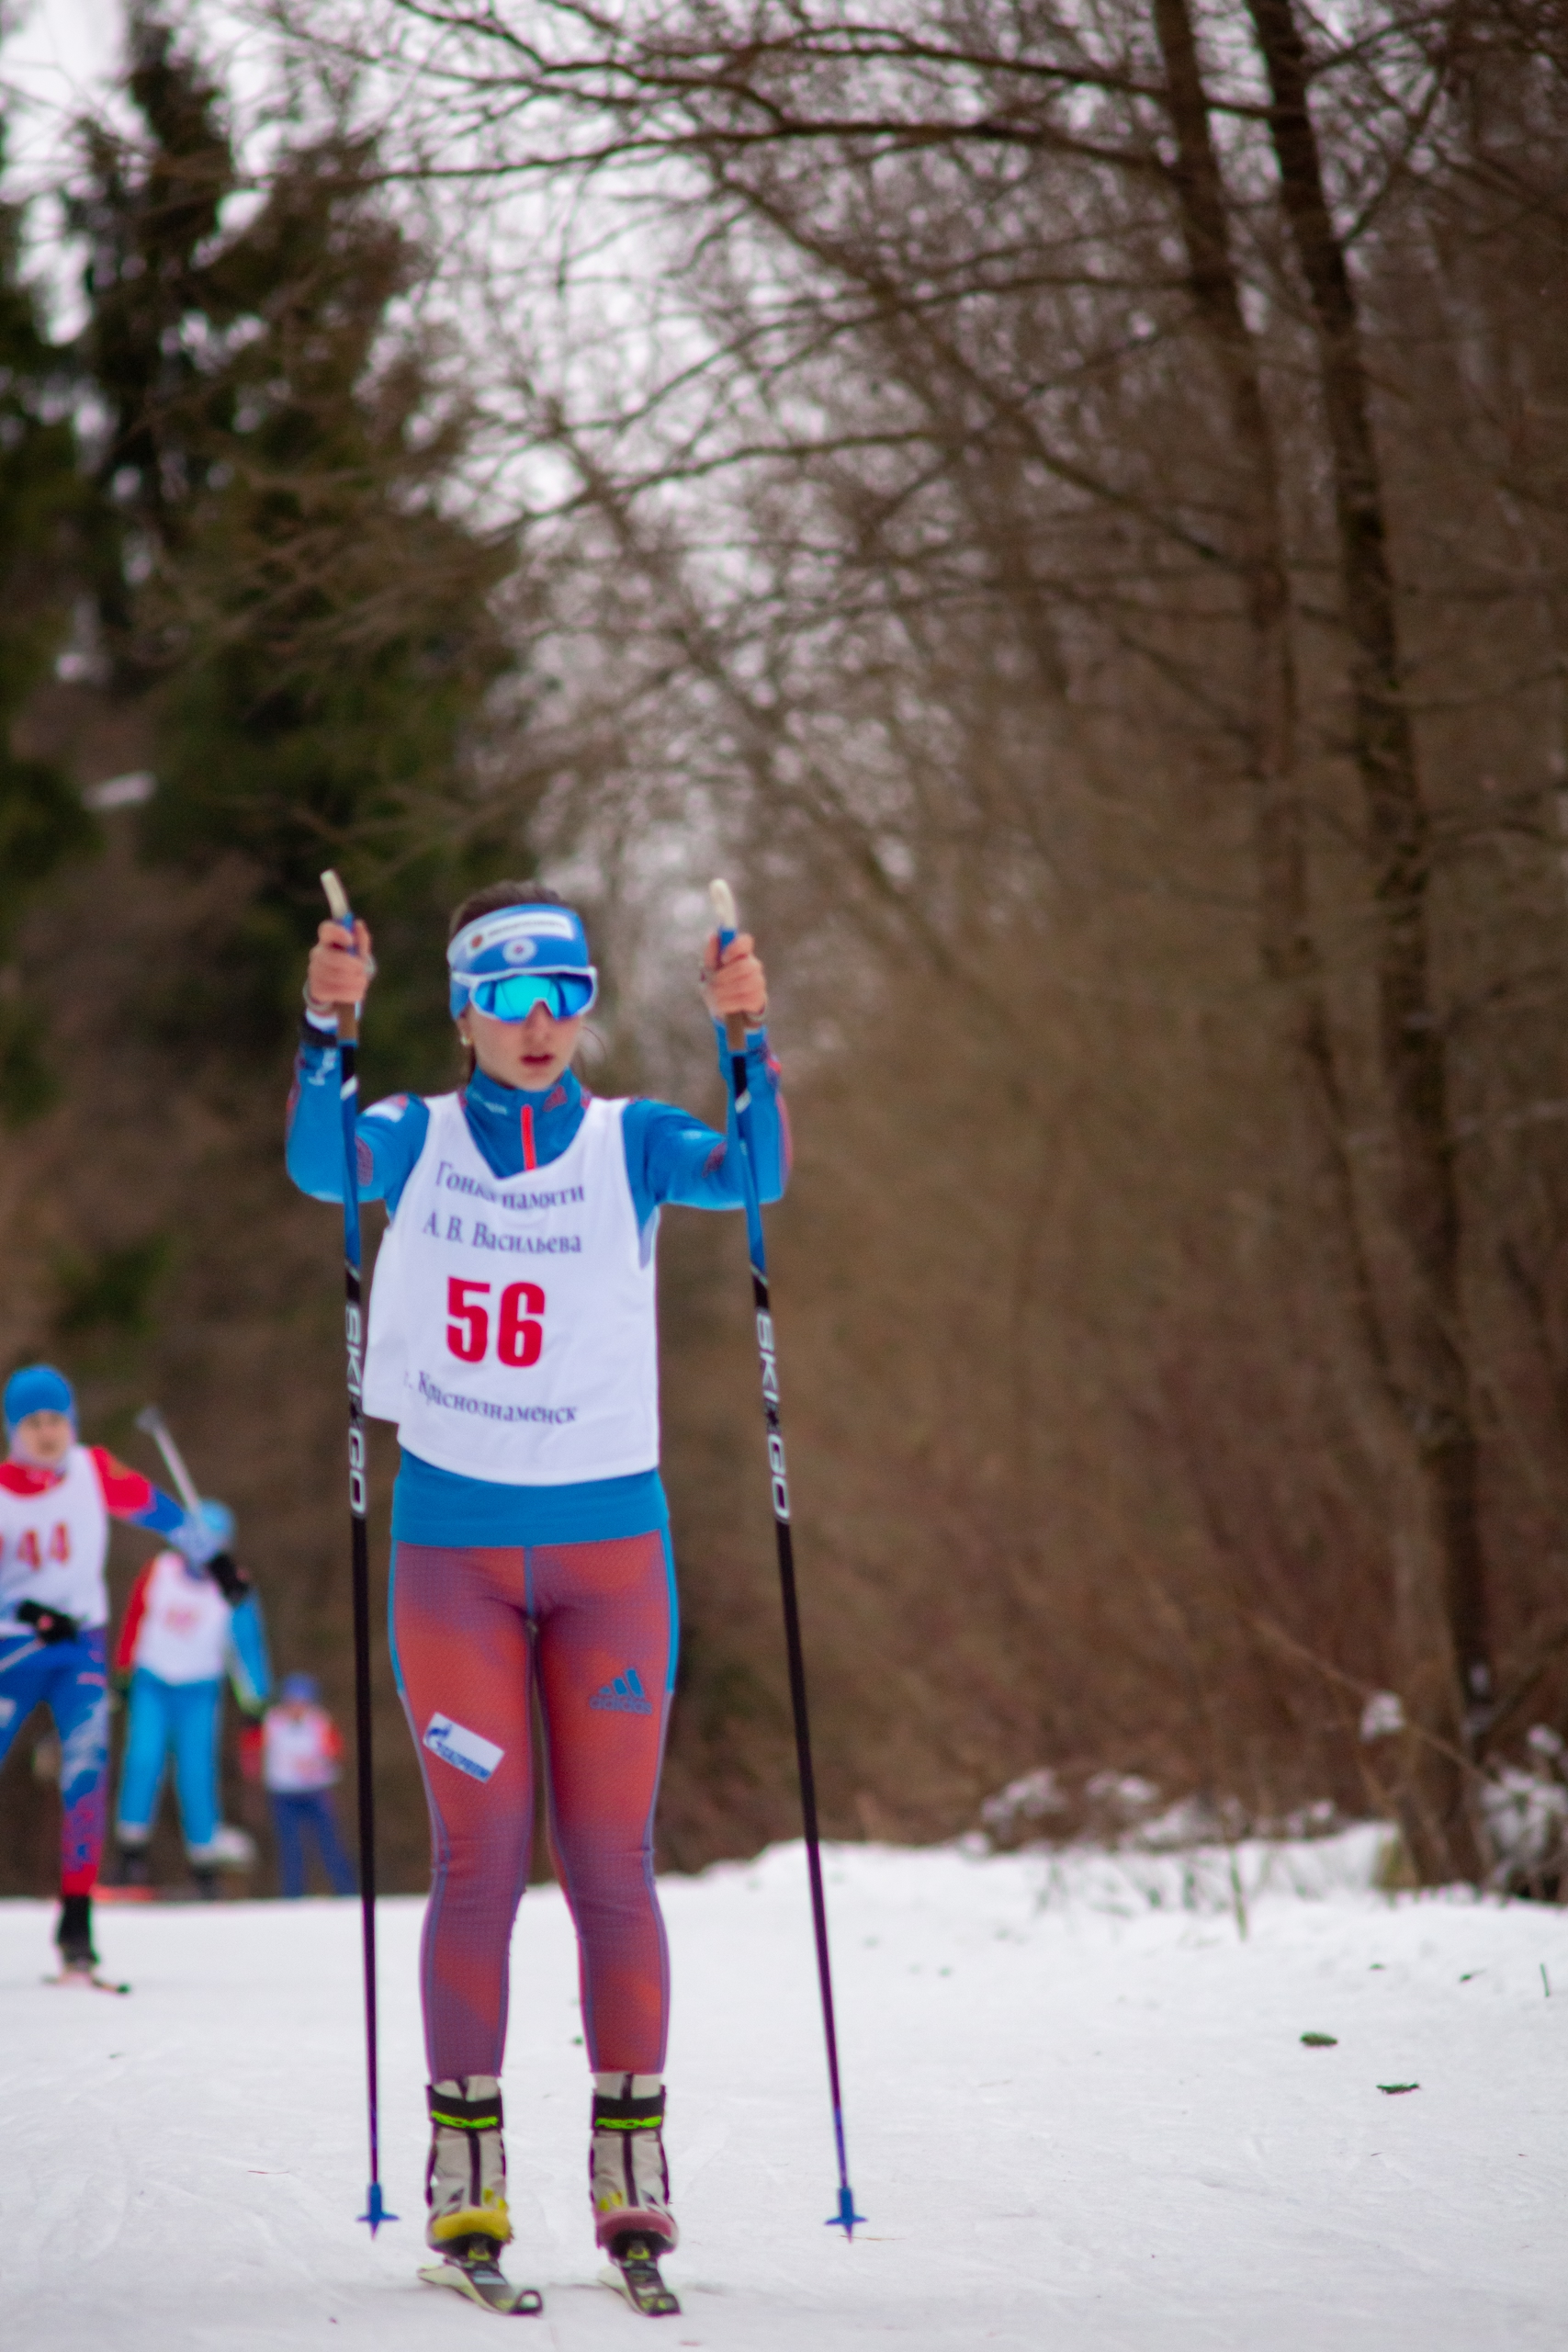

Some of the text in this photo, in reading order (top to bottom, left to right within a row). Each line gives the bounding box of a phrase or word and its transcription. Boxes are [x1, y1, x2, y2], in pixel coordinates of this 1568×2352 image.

[472, 1220, 583, 1254] Васильева
[446, 1275, 546, 1368] 56
[419, 1370, 578, 1425] Краснознаменск
